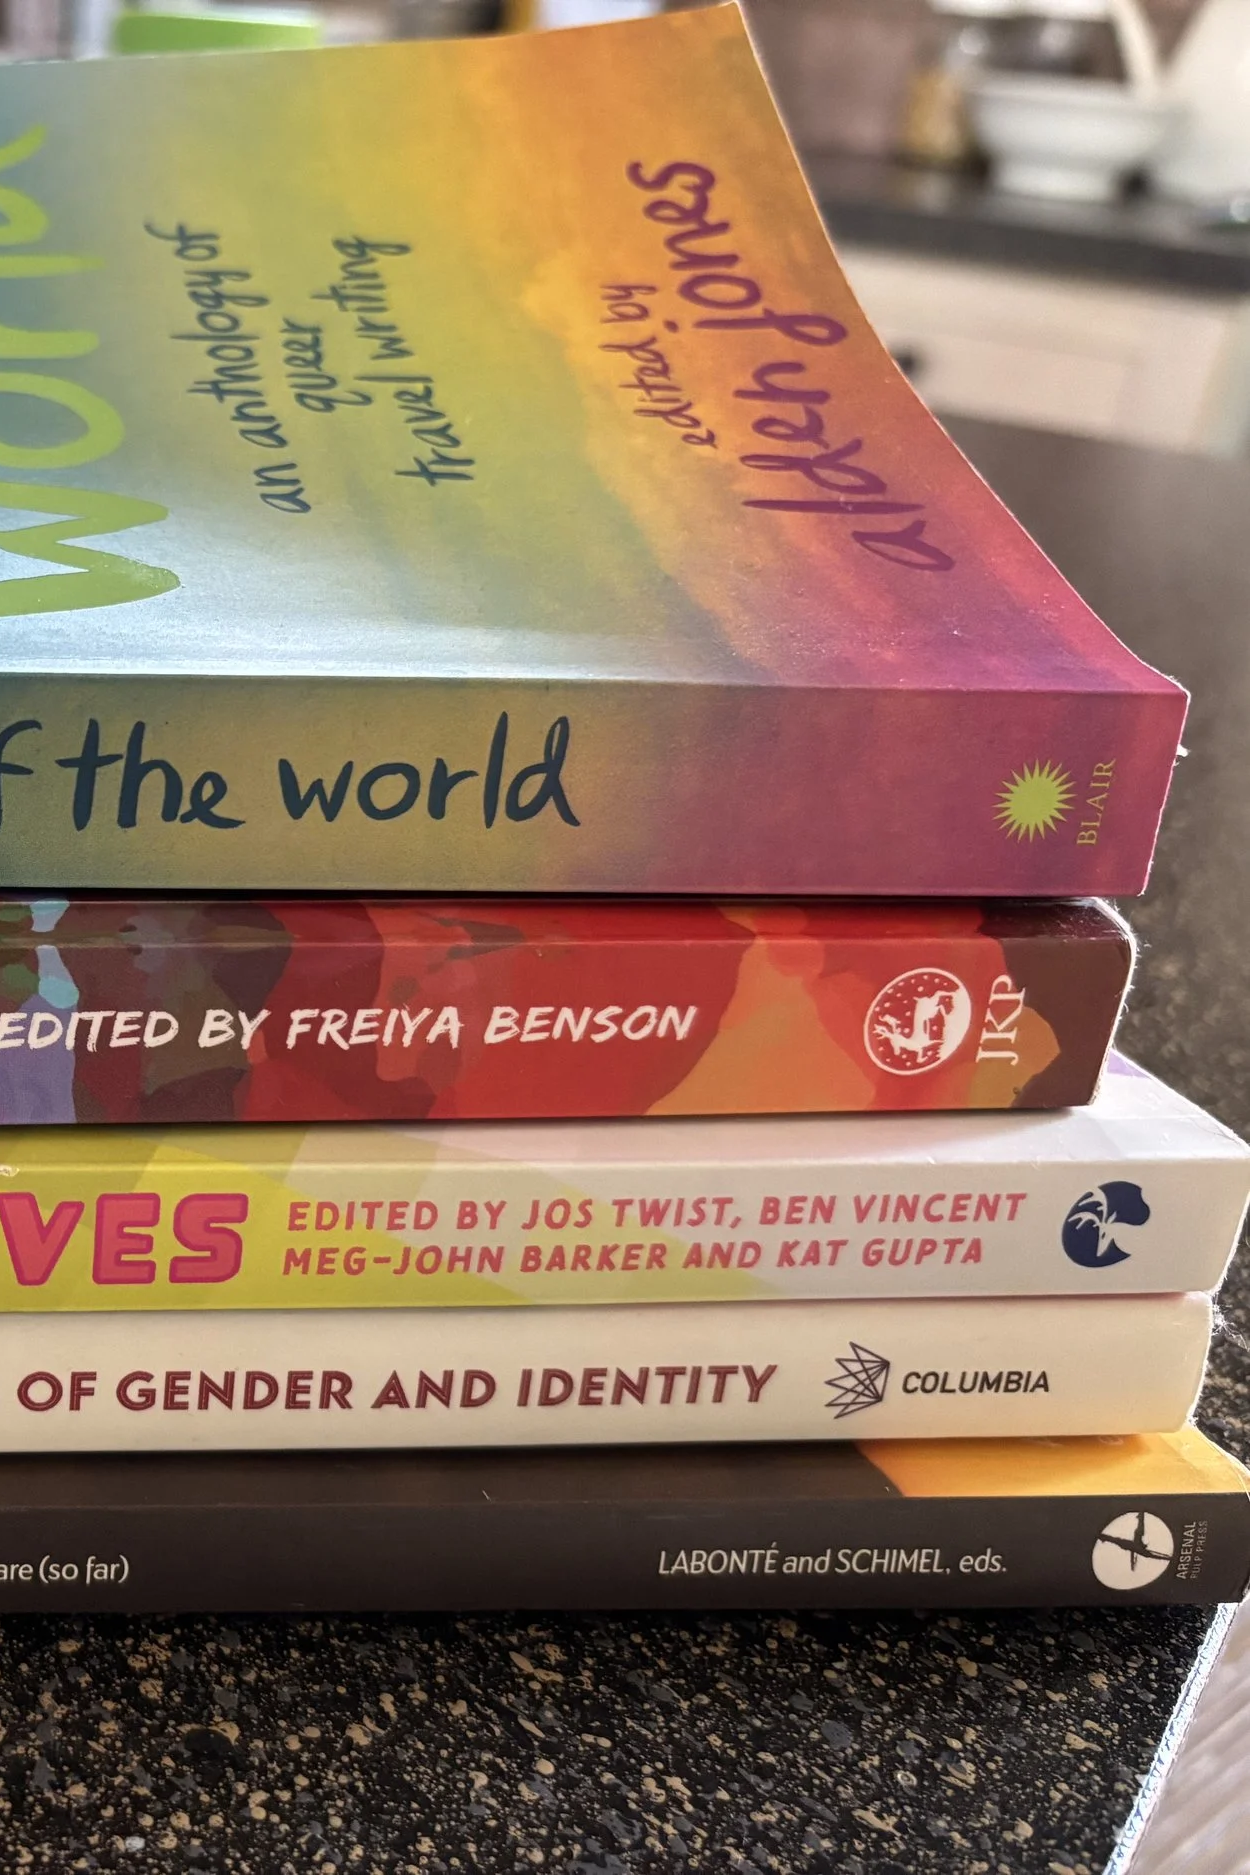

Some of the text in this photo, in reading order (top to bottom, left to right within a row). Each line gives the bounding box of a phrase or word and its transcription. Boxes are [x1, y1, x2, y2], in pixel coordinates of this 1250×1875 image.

[143, 223, 312, 513] an anthology of
[279, 317, 373, 413] queer
[310, 236, 476, 487] travel writing
[598, 284, 718, 450] edited by
[626, 161, 956, 572] alden jones
[54, 718, 247, 831] the
[277, 711, 582, 828] world
[1076, 758, 1117, 845] BLAIR
[198, 1008, 272, 1050] BY
[285, 1006, 464, 1050] FREIYA
[483, 1004, 699, 1045] BENSON
[976, 974, 1026, 1066] JKP
[287, 1193, 1027, 1231] EDITED BY JOS TWIST, BEN VINCENT
[282, 1237, 983, 1276] MEG-JOHN BARKER AND KAT GUPTA
[16, 1371, 97, 1413] OF
[115, 1370, 354, 1412] GENDER
[370, 1369, 497, 1409] AND
[515, 1364, 777, 1407] IDENTITY
[901, 1370, 1050, 1394] COLUMBIA
[39, 1554, 79, 1584] (so
[85, 1554, 129, 1585] far)
[658, 1541, 1008, 1575] LABONTÉ and SCHIMEL, eds.
[1176, 1521, 1196, 1579] ARSENAL
[1190, 1520, 1208, 1579] PULP PRESS
